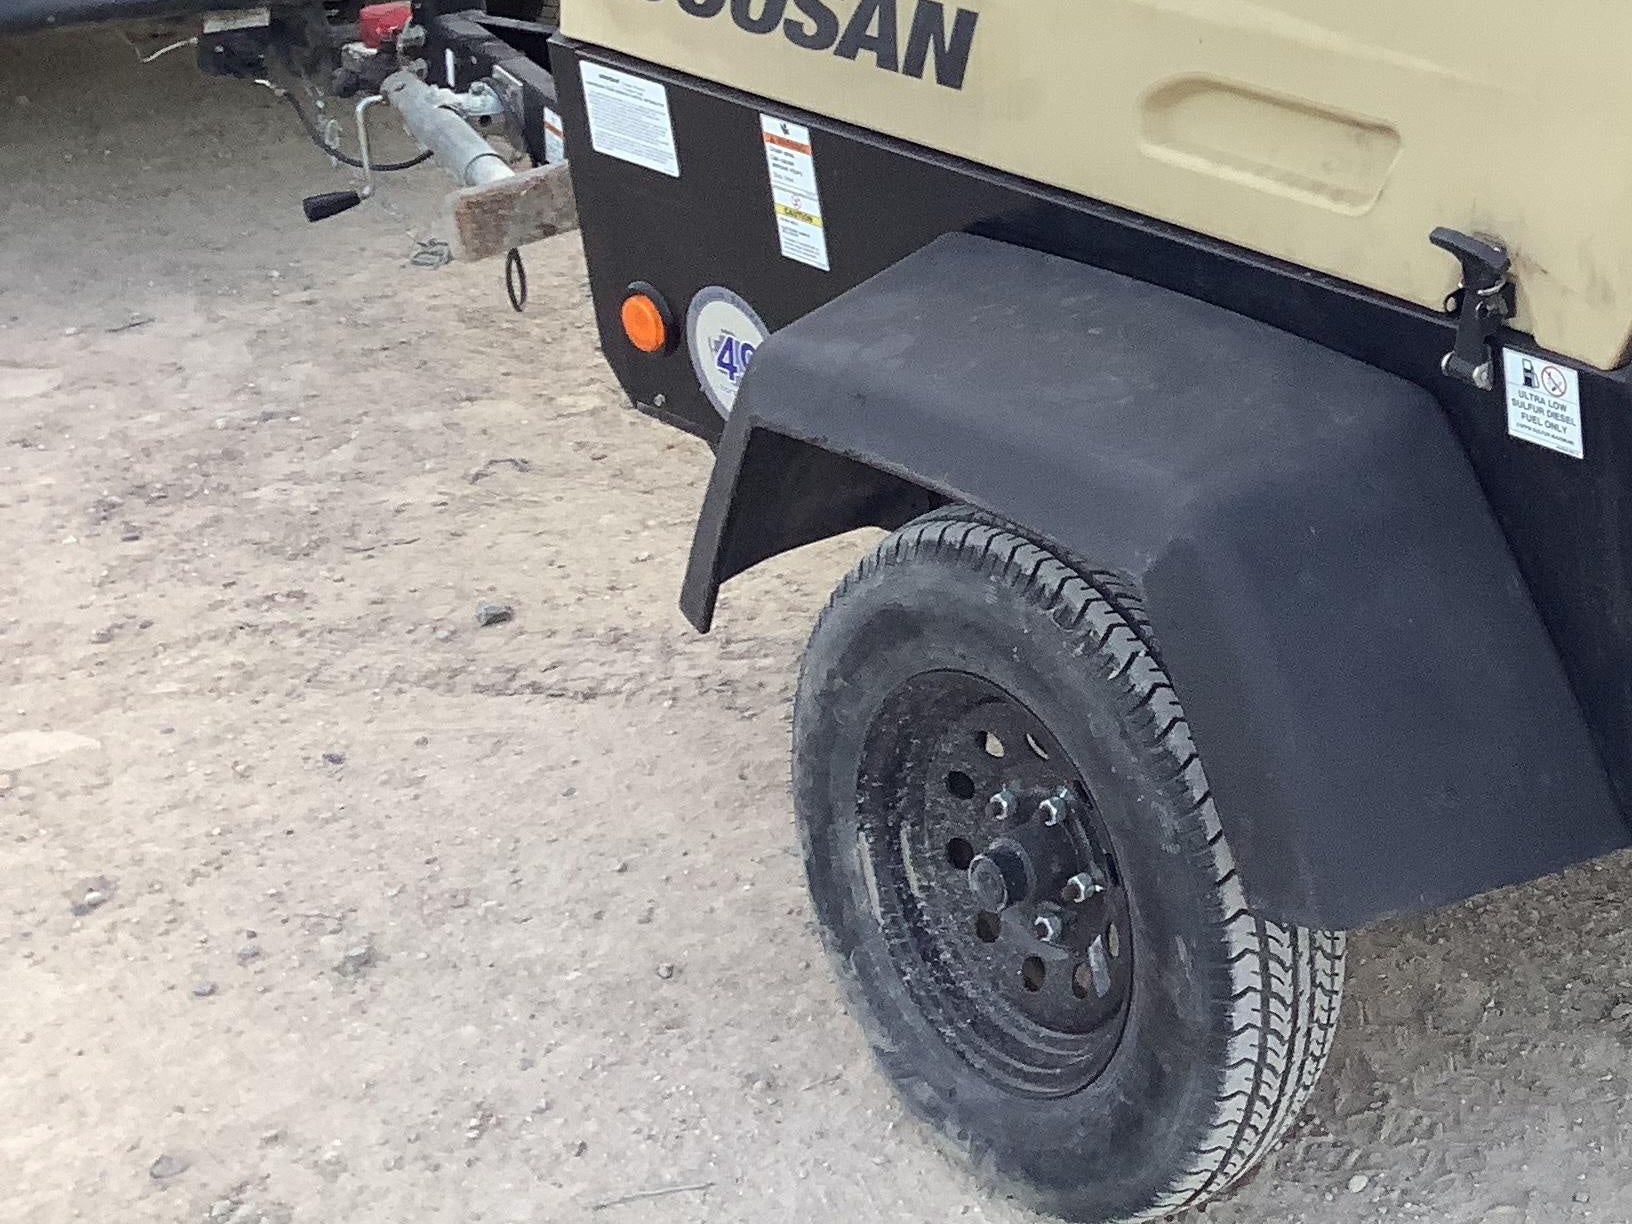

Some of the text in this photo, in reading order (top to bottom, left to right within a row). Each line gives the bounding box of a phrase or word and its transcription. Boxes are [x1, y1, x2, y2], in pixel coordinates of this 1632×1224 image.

[1511, 397, 1577, 427] SULFUR DIESEL
[1518, 389, 1567, 413] ULTRA LOW
[1520, 412, 1543, 426] FUEL
[1544, 419, 1568, 434] ONLY
